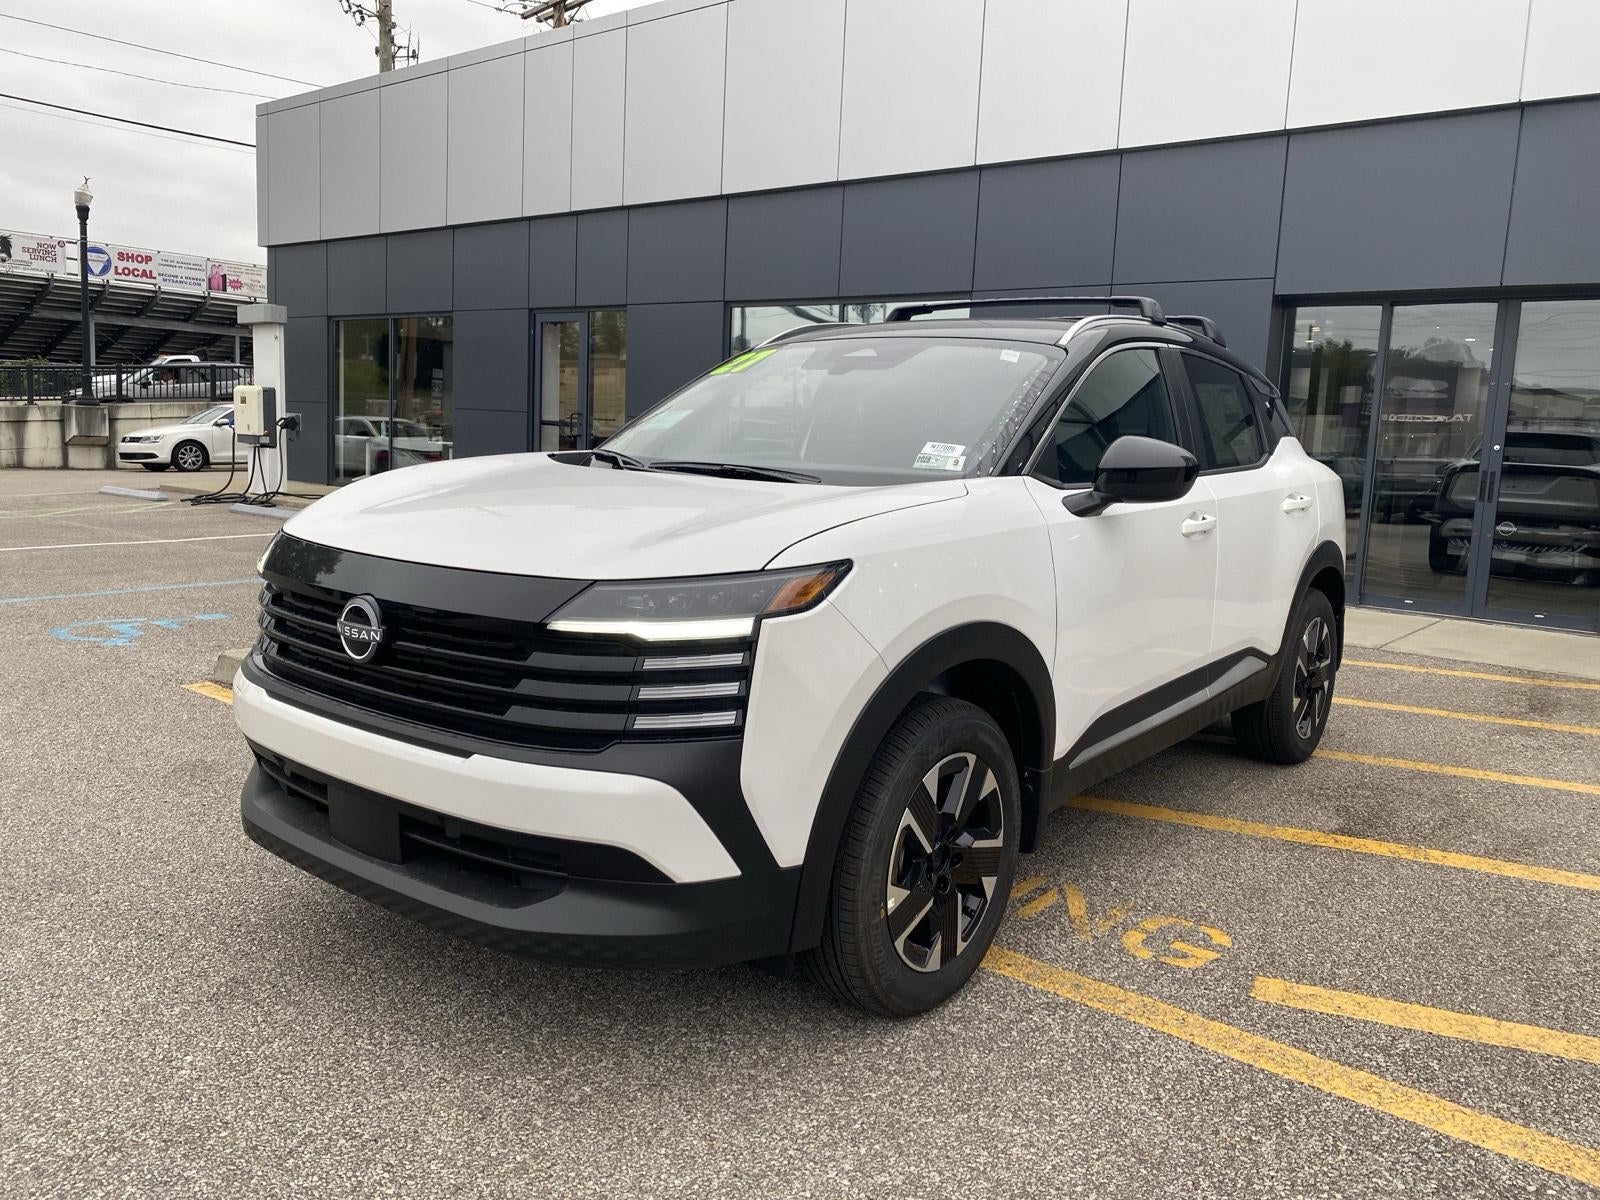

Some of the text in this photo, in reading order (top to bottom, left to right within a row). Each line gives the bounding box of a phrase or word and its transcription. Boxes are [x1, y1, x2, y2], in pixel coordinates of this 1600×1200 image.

[21, 247, 57, 256] SERVING
[37, 242, 57, 250] NOW
[29, 254, 57, 263] LUNCH
[117, 251, 152, 265] SHOP
[114, 265, 157, 279] LOCAL
[337, 620, 381, 641] NISSAN
